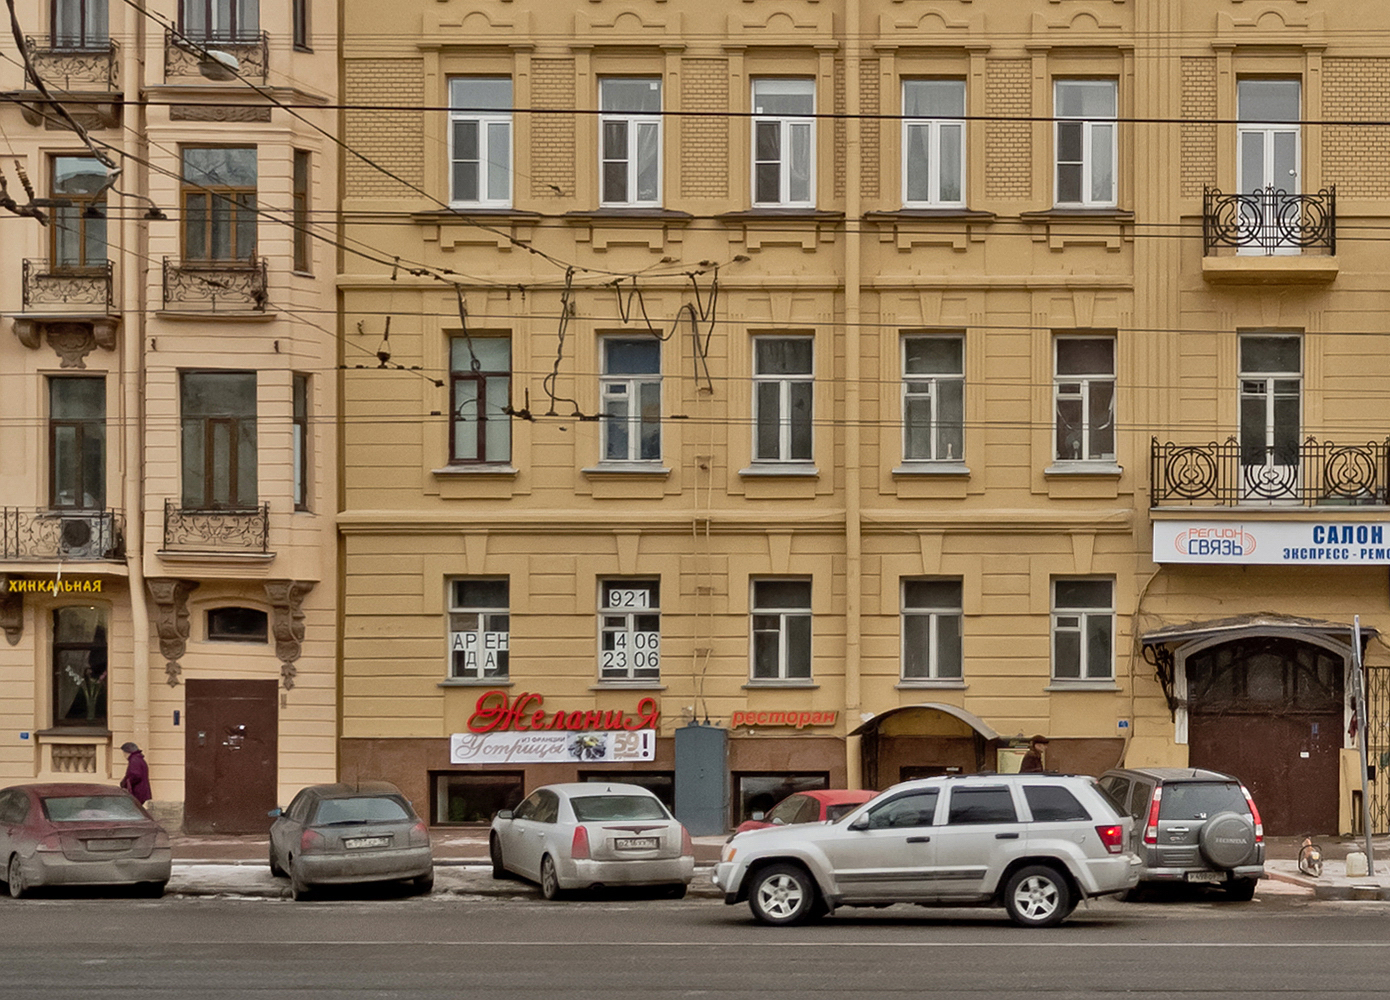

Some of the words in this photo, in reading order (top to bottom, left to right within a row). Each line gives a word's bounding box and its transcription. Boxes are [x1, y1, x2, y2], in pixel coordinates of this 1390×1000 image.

[1312, 525, 1384, 545] САЛОН
[1188, 539, 1243, 556] СВЯЗЬ
[1282, 547, 1350, 560] ЭКСПРЕСС
[8, 579, 103, 592] ХИНКАЛЬНАЯ
[610, 590, 648, 607] 921
[731, 710, 836, 729] ресторан
[454, 732, 565, 763] Устрицы
[614, 732, 640, 753] 59
[1215, 836, 1248, 845] HONDA
